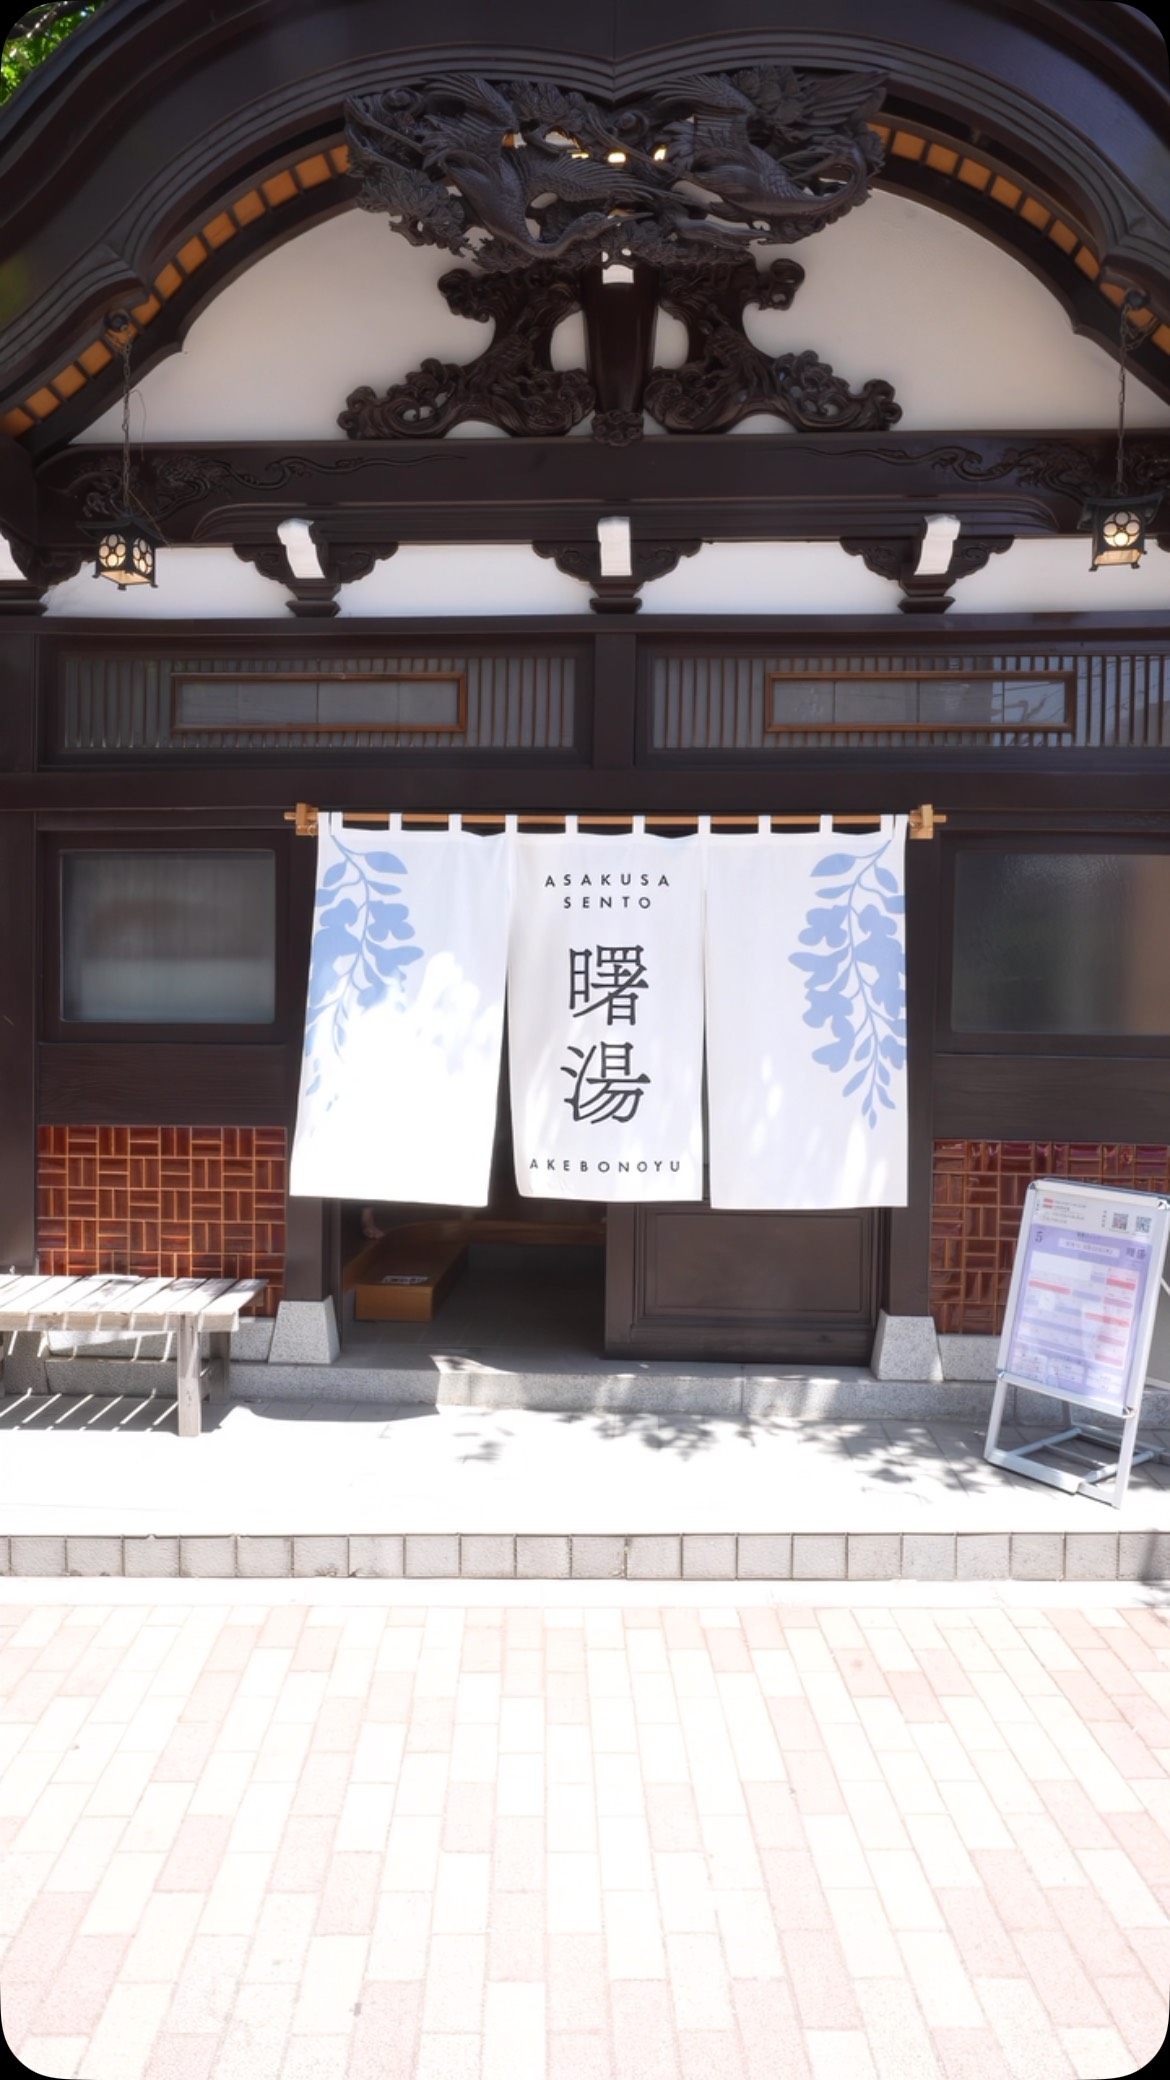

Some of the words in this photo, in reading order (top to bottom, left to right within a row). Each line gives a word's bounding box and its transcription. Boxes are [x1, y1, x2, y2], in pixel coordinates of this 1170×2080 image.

[545, 873, 670, 888] ASAKUSA
[563, 896, 651, 910] SENTO
[560, 944, 651, 1125] 曙湯
[529, 1158, 681, 1173] AKEBONOYU
